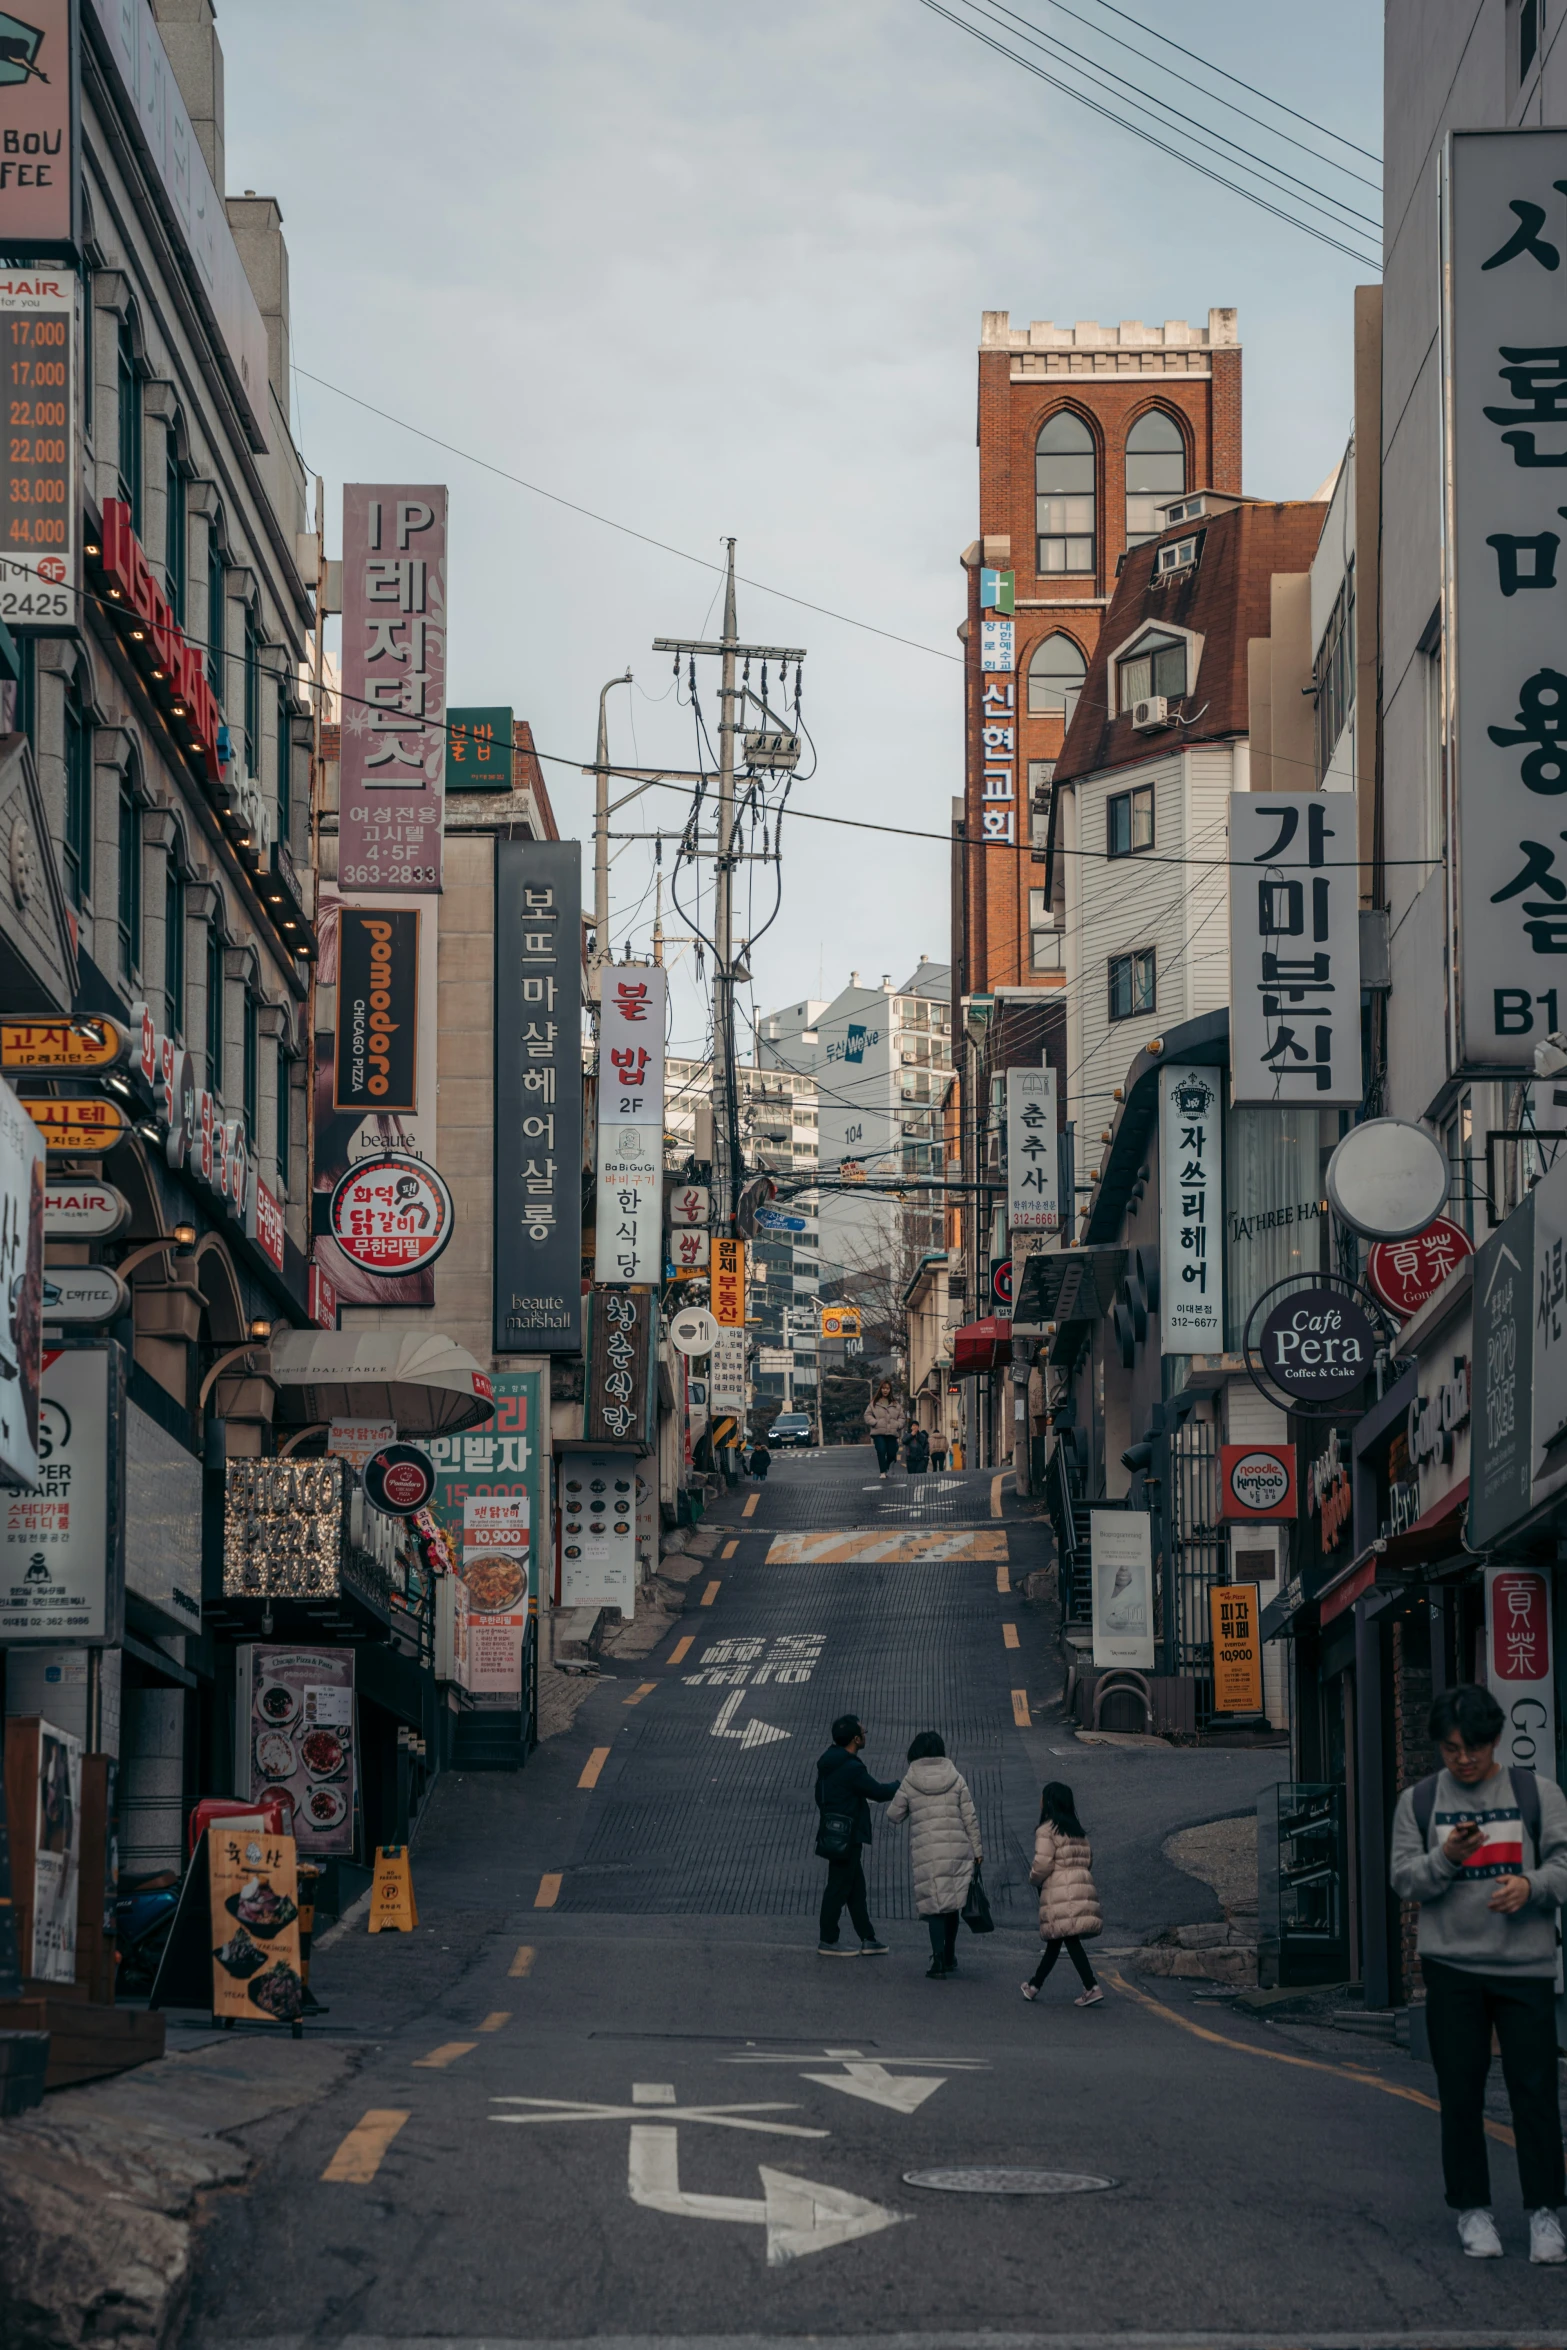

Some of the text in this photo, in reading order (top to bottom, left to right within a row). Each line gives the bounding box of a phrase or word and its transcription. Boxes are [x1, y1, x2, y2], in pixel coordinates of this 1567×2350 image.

[20, 298, 41, 309] you
[10, 321, 65, 348] 17,000
[10, 361, 65, 388] 17,000
[10, 401, 65, 428] 22,000
[10, 438, 65, 465] 22,000
[10, 479, 65, 505] 33,000
[10, 519, 65, 545] 44,000
[368, 500, 435, 550] IP
[983, 622, 996, 670] 장로회
[998, 622, 1013, 670] 대한예수교
[360, 557, 427, 790] 레지던스
[448, 722, 494, 762] 불밥
[981, 683, 1016, 845] 신현교회
[348, 806, 438, 825] 여성전용
[361, 825, 425, 843] 고시텔
[343, 864, 436, 884] 363-2833
[1253, 802, 1336, 1091] 가미분식
[361, 920, 401, 1097] pomodoro
[1493, 988, 1558, 1035] B1
[351, 998, 365, 1093] CHICAGO PIZZA
[520, 886, 560, 1242] 보뜨마샬헤어살롱
[619, 1097, 644, 1113] 2F
[25, 1105, 107, 1136] 시텔
[46, 1135, 97, 1147] 지던스
[845, 1123, 862, 1144] 104
[1020, 1103, 1048, 1194] 춘추사
[605, 1174, 656, 1187] 바비구기
[352, 1183, 394, 1206] 화덕
[674, 1189, 706, 1222] 불
[1013, 1200, 1057, 1211] 학위가운전문
[1178, 1126, 1207, 1294] 자쓰리헤어
[348, 1206, 416, 1234] 닭갈비
[1013, 1212, 1057, 1225] 312-6661
[615, 1189, 643, 1279] 한식당
[352, 1236, 420, 1258] 무한리필
[679, 1231, 703, 1264] 밥
[718, 1241, 739, 1323] 원제 부동산
[511, 1293, 563, 1312] beauté
[1175, 1303, 1212, 1315] 이대본점
[505, 1311, 571, 1331] marshall
[1170, 1316, 1218, 1329] 312-6677
[845, 1336, 864, 1357] 104
[1273, 1329, 1364, 1365] Pera
[1486, 1317, 1517, 1392] POPO
[602, 1296, 638, 1437] 청춘식당
[1284, 1366, 1355, 1379] Coffee & Cake
[511, 1384, 528, 1393] 함께
[714, 1384, 743, 1393] 데코타일
[1486, 1372, 1516, 1449] TREE
[331, 1427, 388, 1441] 화덕 닭갈비
[414, 1436, 533, 1473] 인받자
[1239, 1463, 1283, 1477] noodle
[228, 1466, 337, 1513] CHICAGO
[1237, 1475, 1284, 1491] kimbob
[1262, 1487, 1277, 1501] 김밥
[7, 1502, 70, 1517] 스터디카페
[474, 1506, 519, 1519] 팬 닭갈비
[7, 1517, 70, 1531] 스터디룸
[242, 1519, 322, 1550] PIZZA
[7, 1533, 71, 1543] 모임전문공간
[474, 1530, 521, 1546] 10,900
[242, 1558, 322, 1586] & PUB
[2, 1617, 29, 1627] 이대점
[478, 1615, 512, 1627] 무한리필
[1220, 1602, 1250, 1621] 피자
[1221, 1621, 1250, 1640] 뷔페
[272, 1655, 333, 1670] Chicago Pizza & Pasta
[1219, 1648, 1253, 1663] 10,900
[283, 1670, 324, 1680] pomodoro
[1444, 1810, 1512, 1824] TOMMY
[223, 1991, 246, 1999] STEAK
